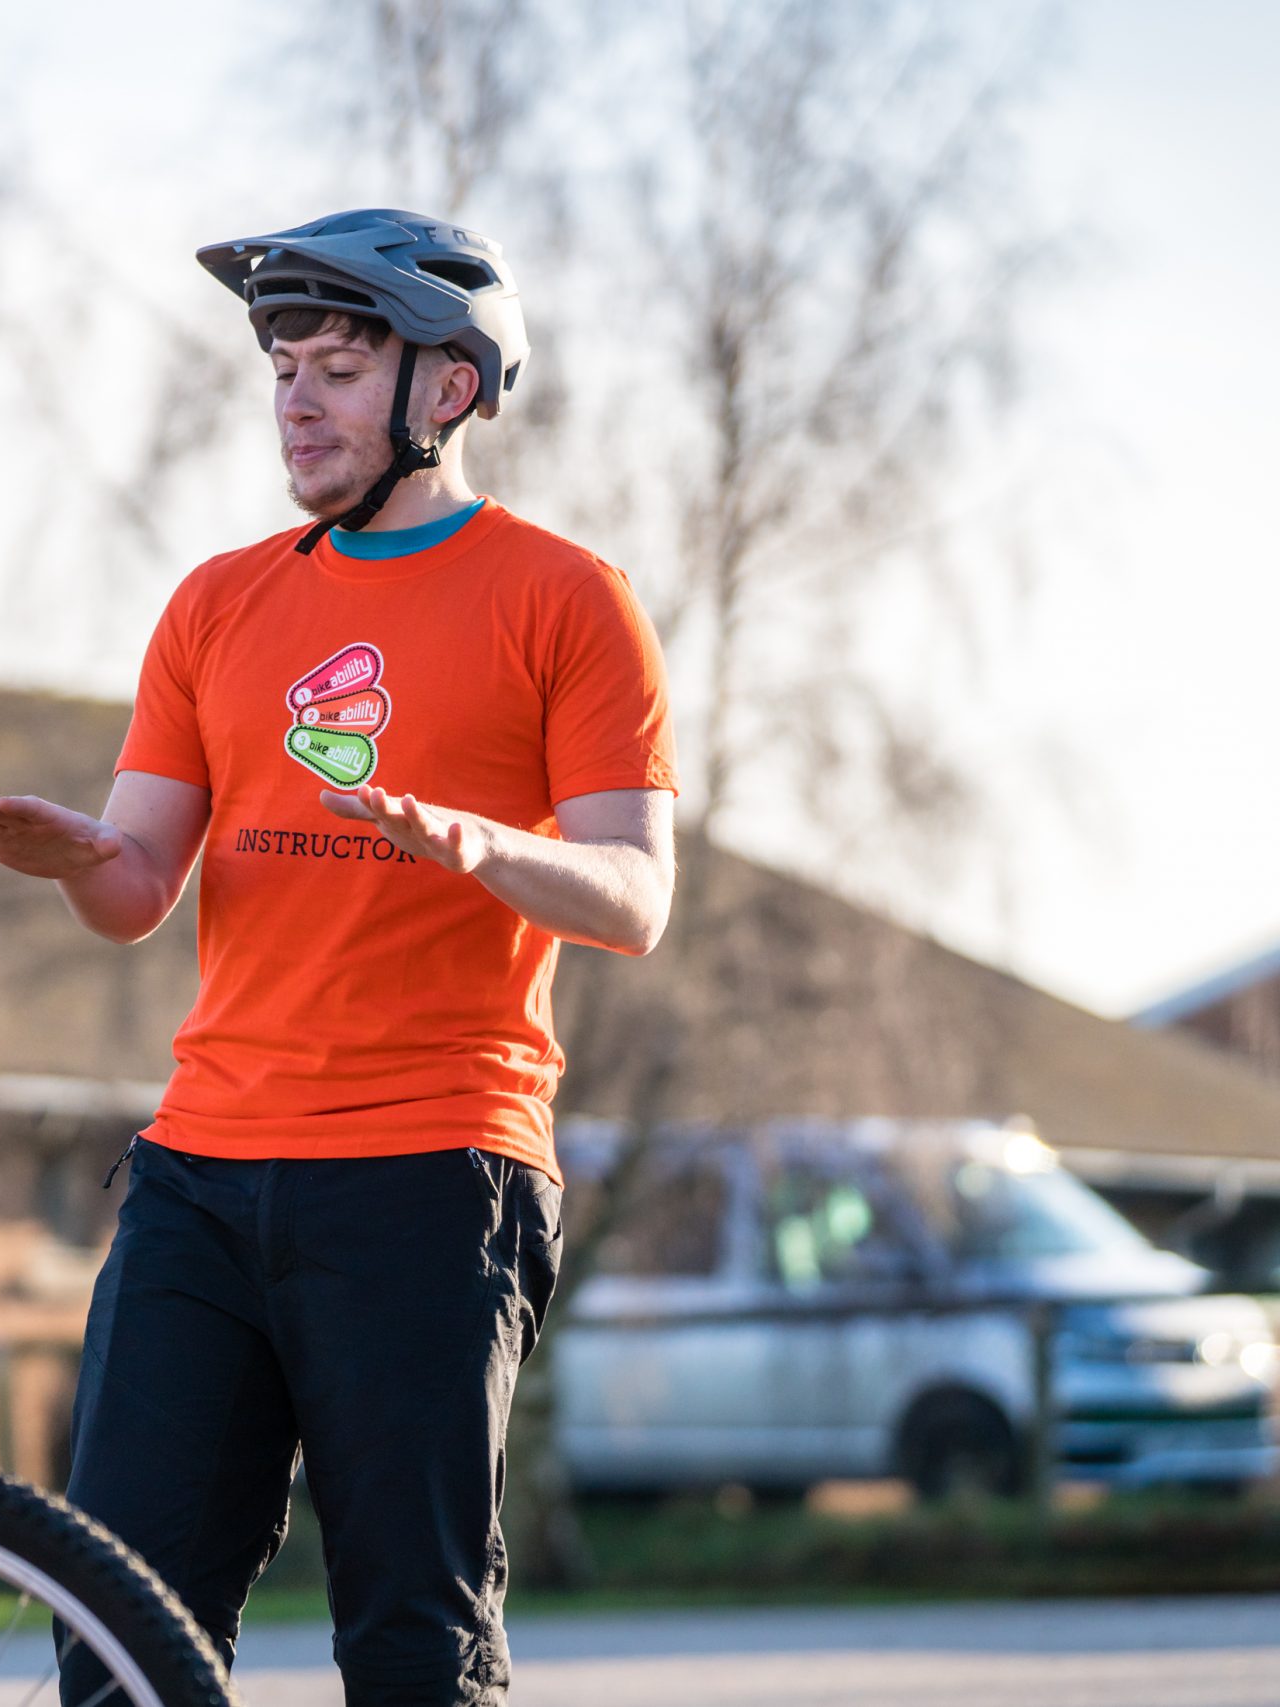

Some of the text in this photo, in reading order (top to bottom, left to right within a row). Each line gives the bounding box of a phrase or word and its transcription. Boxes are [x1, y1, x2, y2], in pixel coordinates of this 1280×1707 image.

[312, 655, 373, 696] bikeability
[308, 700, 381, 725] 2 bikeability
[309, 740, 367, 775] bikeability
